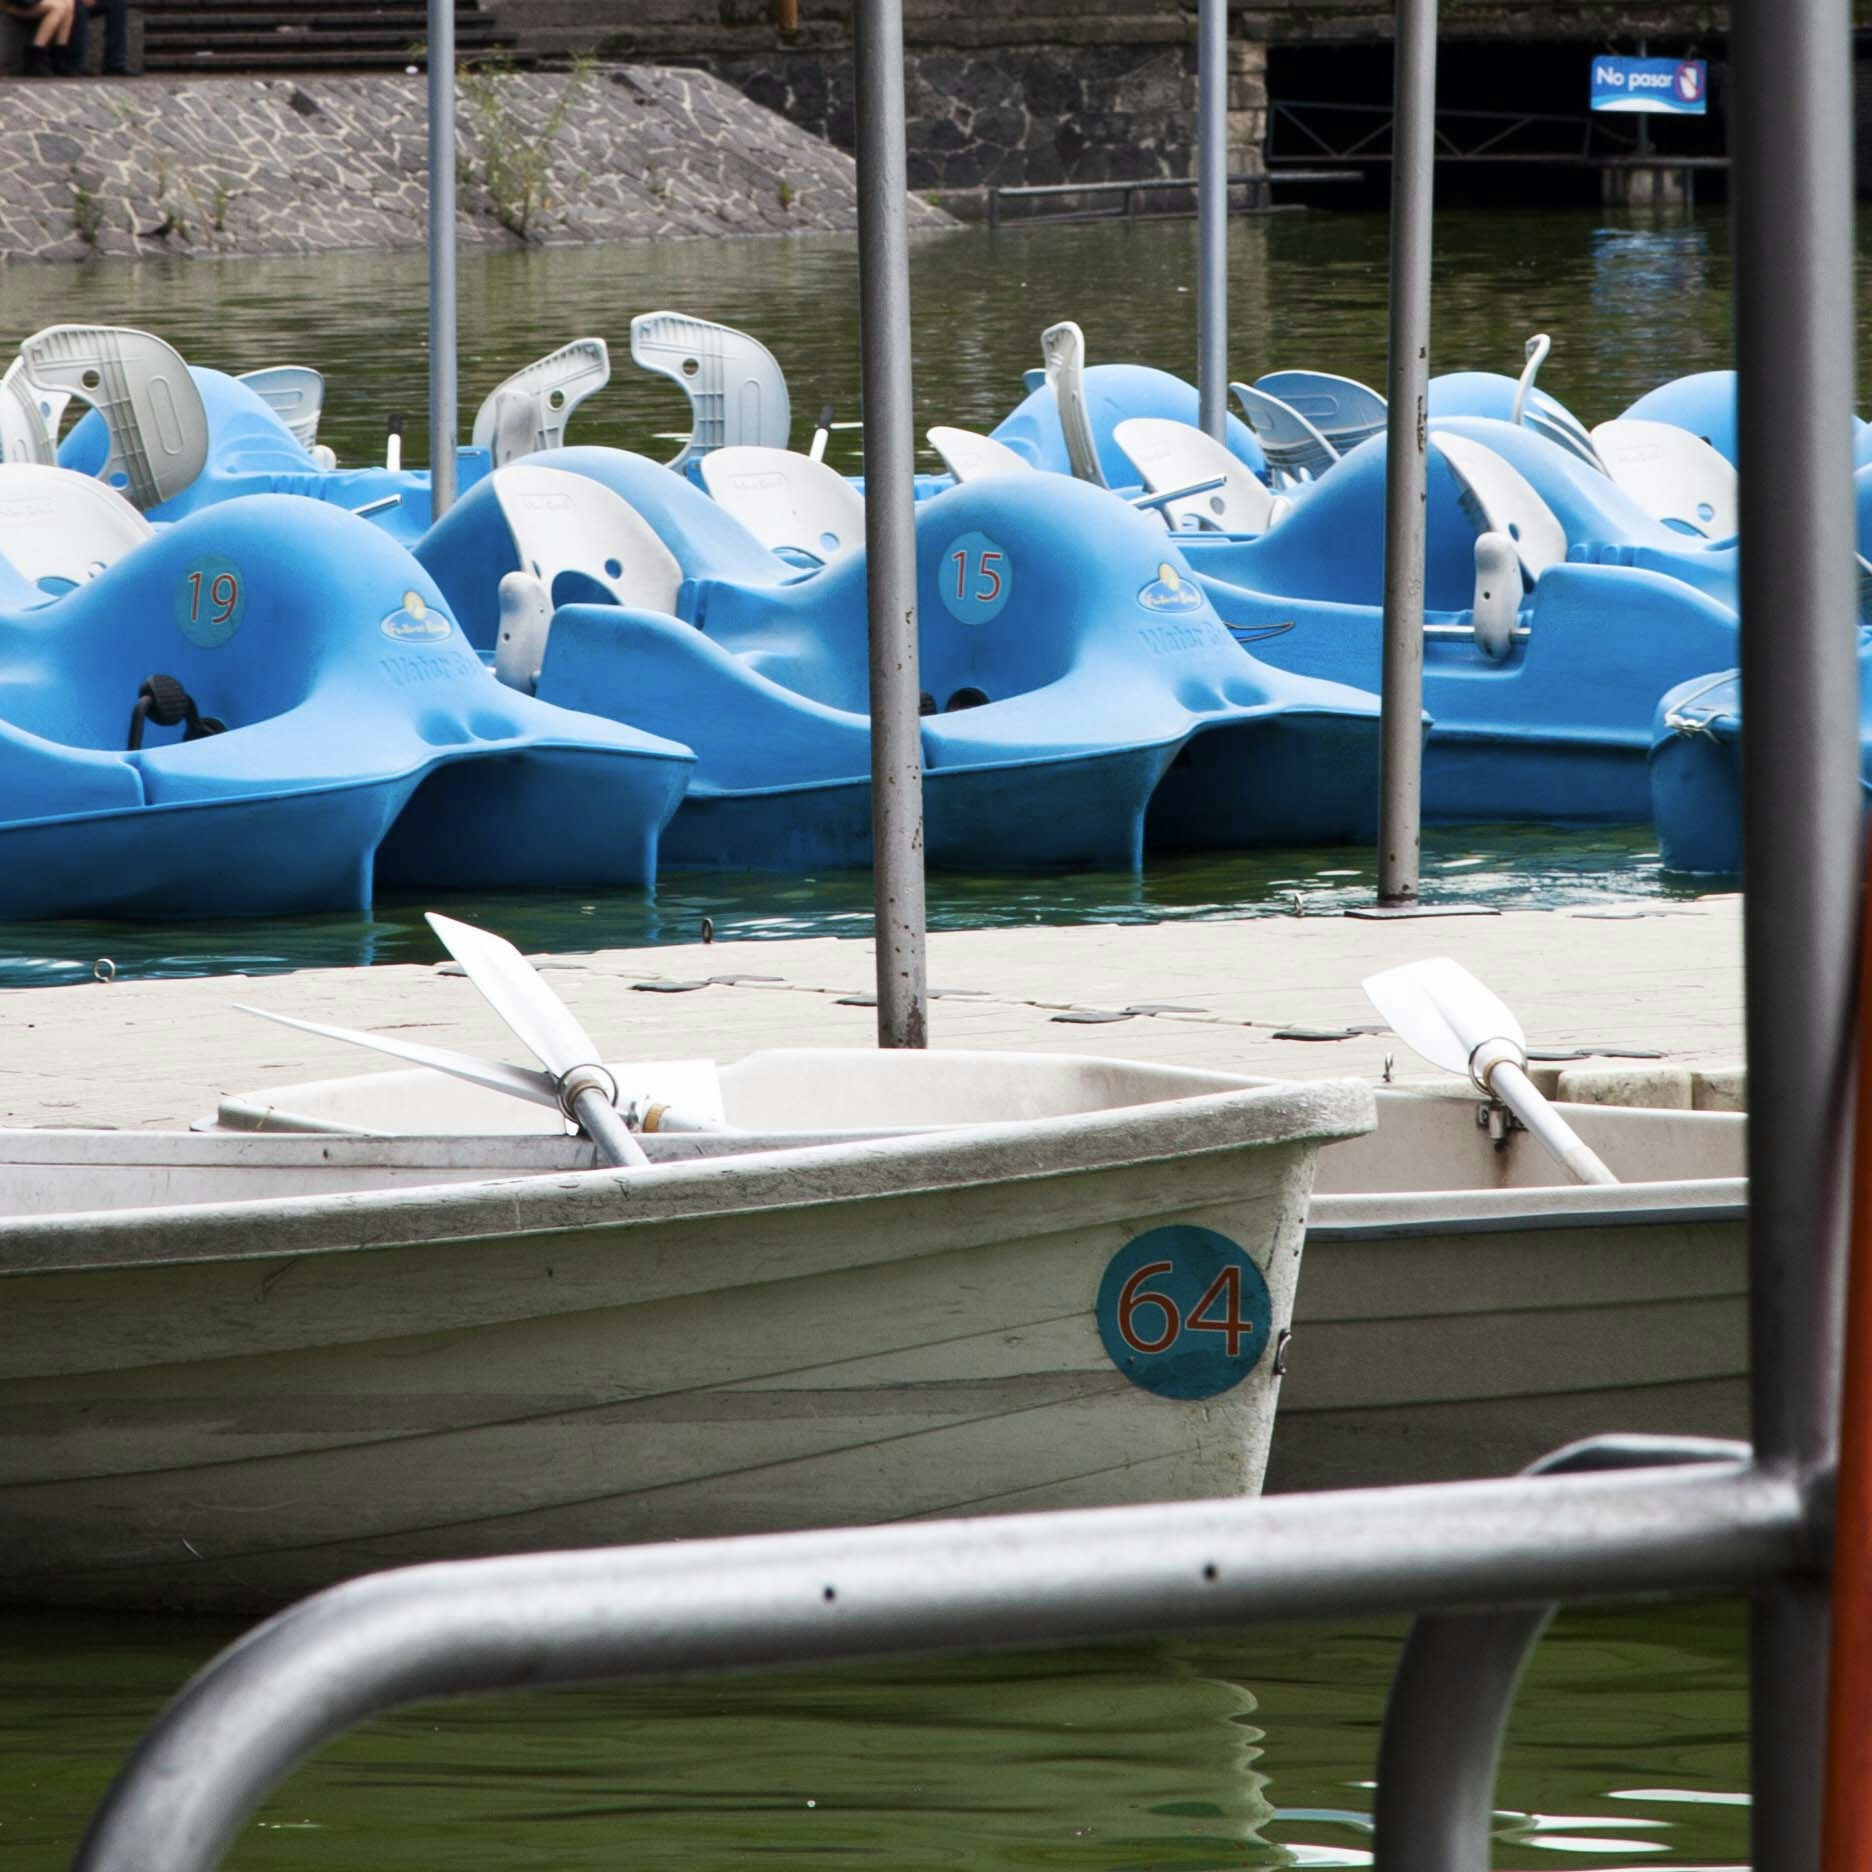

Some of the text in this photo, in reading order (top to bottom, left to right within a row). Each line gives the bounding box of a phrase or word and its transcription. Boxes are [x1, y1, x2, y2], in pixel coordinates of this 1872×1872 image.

[1596, 66, 1674, 92] No pasar
[188, 571, 238, 624] 19
[952, 549, 1004, 602] 15
[1116, 1260, 1254, 1357] 64
